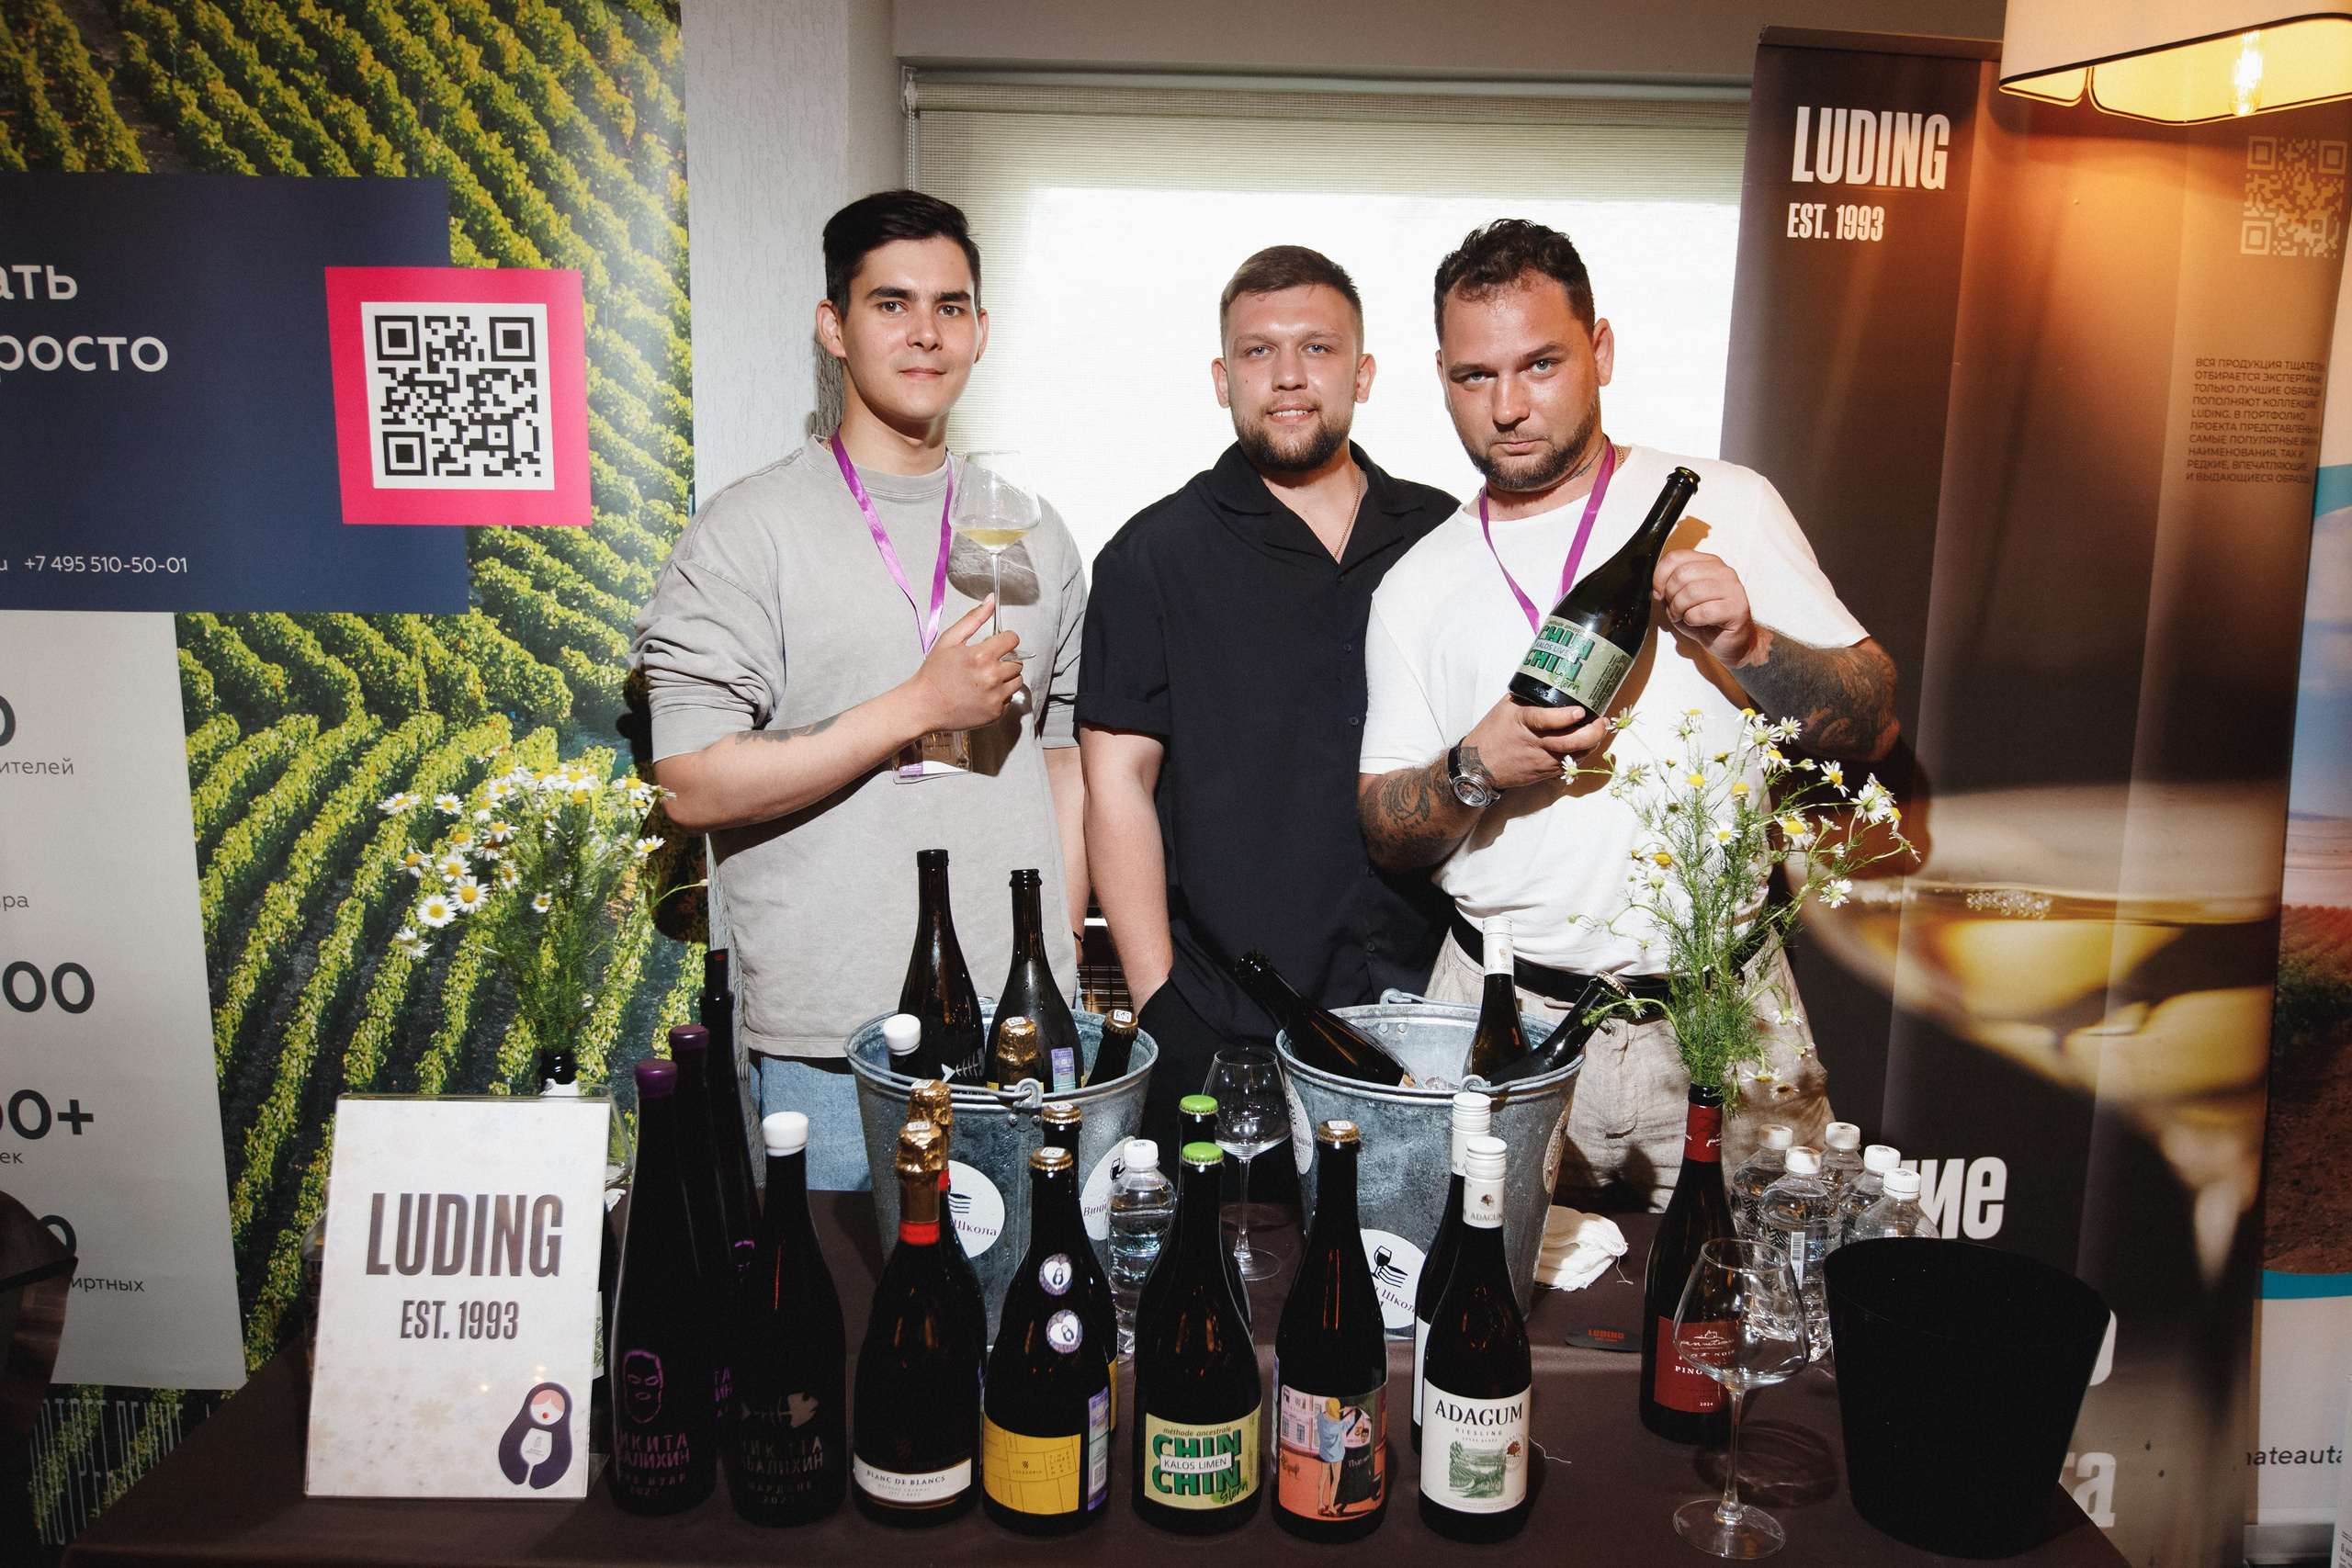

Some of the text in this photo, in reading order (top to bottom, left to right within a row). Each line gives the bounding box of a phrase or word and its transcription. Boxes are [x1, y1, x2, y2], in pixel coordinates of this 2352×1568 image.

[1792, 106, 1951, 190] LUDING
[1787, 202, 1885, 243] EST. 1993
[2196, 357, 2215, 367] ВСЯ
[2218, 358, 2282, 369] ПРОДУКЦИЯ
[2194, 370, 2260, 382] ОТБИРАЕТСЯ
[2194, 383, 2235, 393] ТОЛЬКО
[2236, 385, 2281, 395] ЛУЧШИЕ
[2192, 396, 2319, 410] ПОПОЛНЯЮТ КОЛЛЕКЦИЮ
[2191, 409, 2306, 421] LUDING. В ПОРТФОЛИО
[2190, 422, 2237, 432] ПРОЕКТА
[2189, 434, 2227, 445] САМЫЕ
[2229, 435, 2300, 446] ПОПУЛЯРНЫЕ
[2280, 448, 2297, 457] ТАК
[2232, 460, 2309, 471] ВПЕЧАТЛЯЮЩИЕ
[2186, 472, 2194, 481] И
[2196, 472, 2274, 483] ВЫДАЮЩИЕСЯ
[25, 555, 46, 571] +7
[51, 556, 86, 572] 495
[91, 556, 188, 573] 510-50-01
[1535, 641, 1554, 651] KALOS
[1536, 625, 1596, 661] CHIN
[1523, 648, 1584, 682] CHIN
[0, 894, 29, 911] ра
[0, 1089, 95, 1140] 0+
[953, 1218, 998, 1236] Школа
[366, 1192, 564, 1278] LUDING
[401, 1299, 520, 1340] EST. 1993
[1674, 1365, 1703, 1376] PINO
[1434, 1398, 1523, 1427] ADAGUM
[1162, 1425, 1232, 1437] méthode ancestrale
[1454, 1427, 1503, 1436] RIESLING
[1152, 1428, 1242, 1460] CHIN
[1164, 1457, 1227, 1470] KALOS LIMEN
[865, 1470, 892, 1482] BLANC
[910, 1475, 946, 1485] BLANCS
[1152, 1460, 1241, 1496] CHIN
